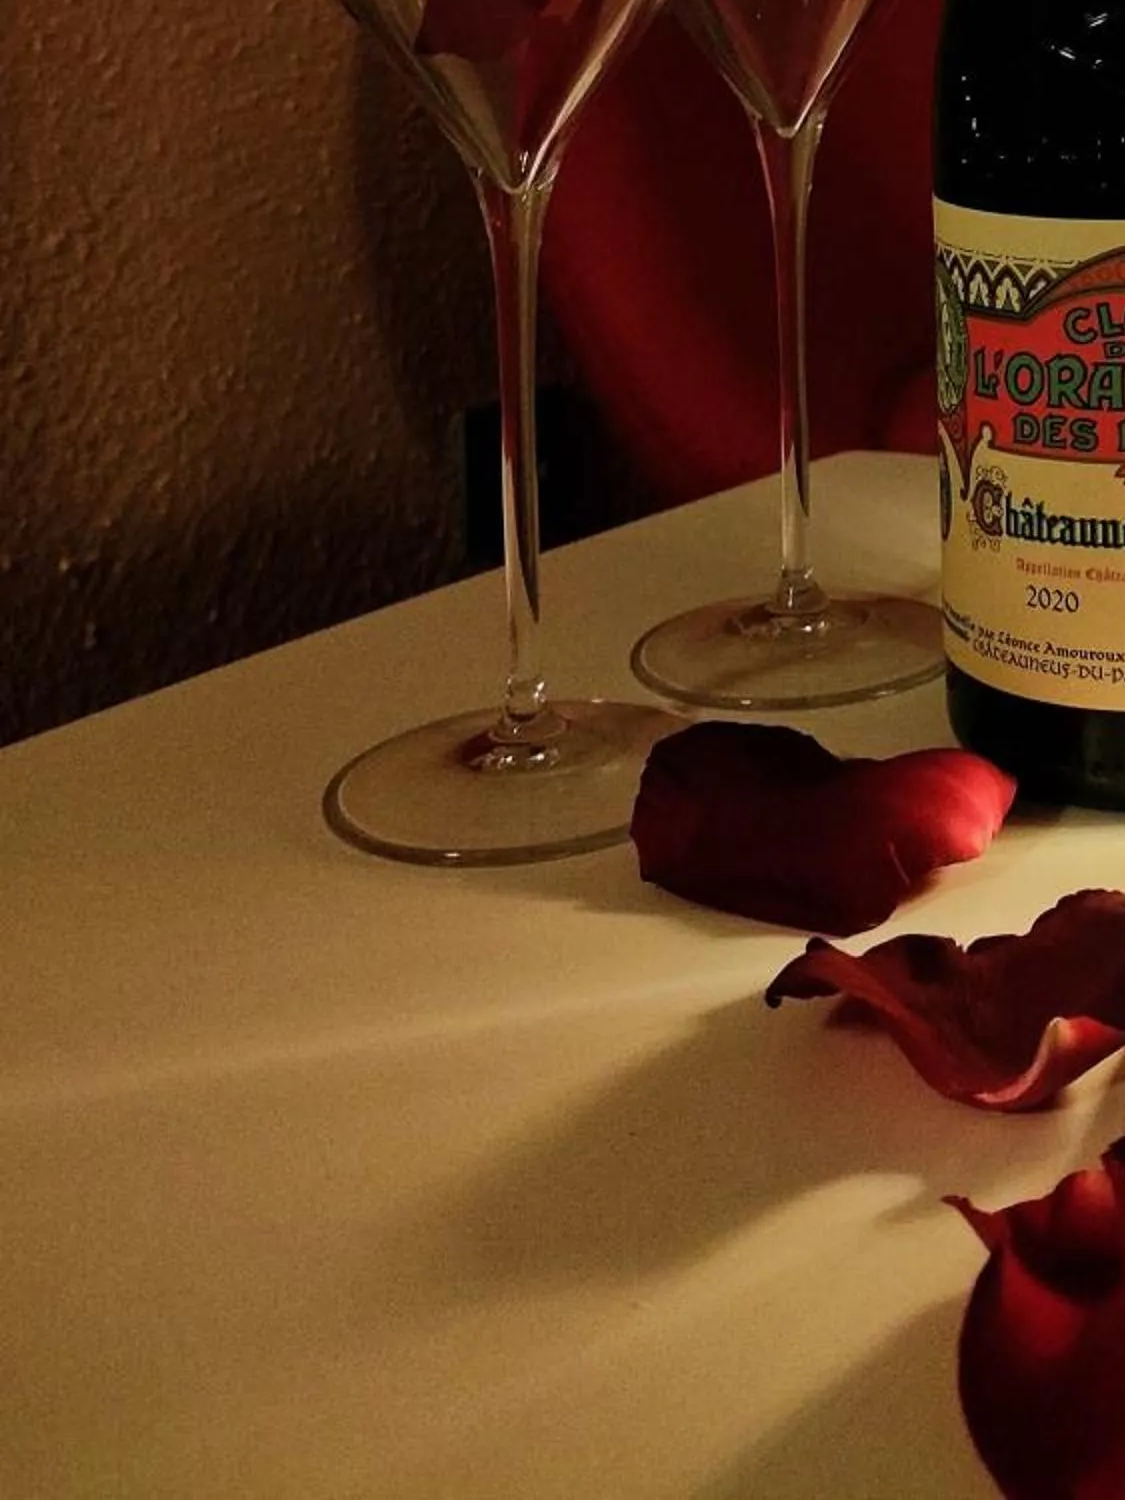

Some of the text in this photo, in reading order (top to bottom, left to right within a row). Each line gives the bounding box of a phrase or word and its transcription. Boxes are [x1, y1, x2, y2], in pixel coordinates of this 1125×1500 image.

[1012, 411, 1099, 452] DES
[1026, 585, 1080, 613] 2020
[1043, 640, 1125, 663] Amouroux
